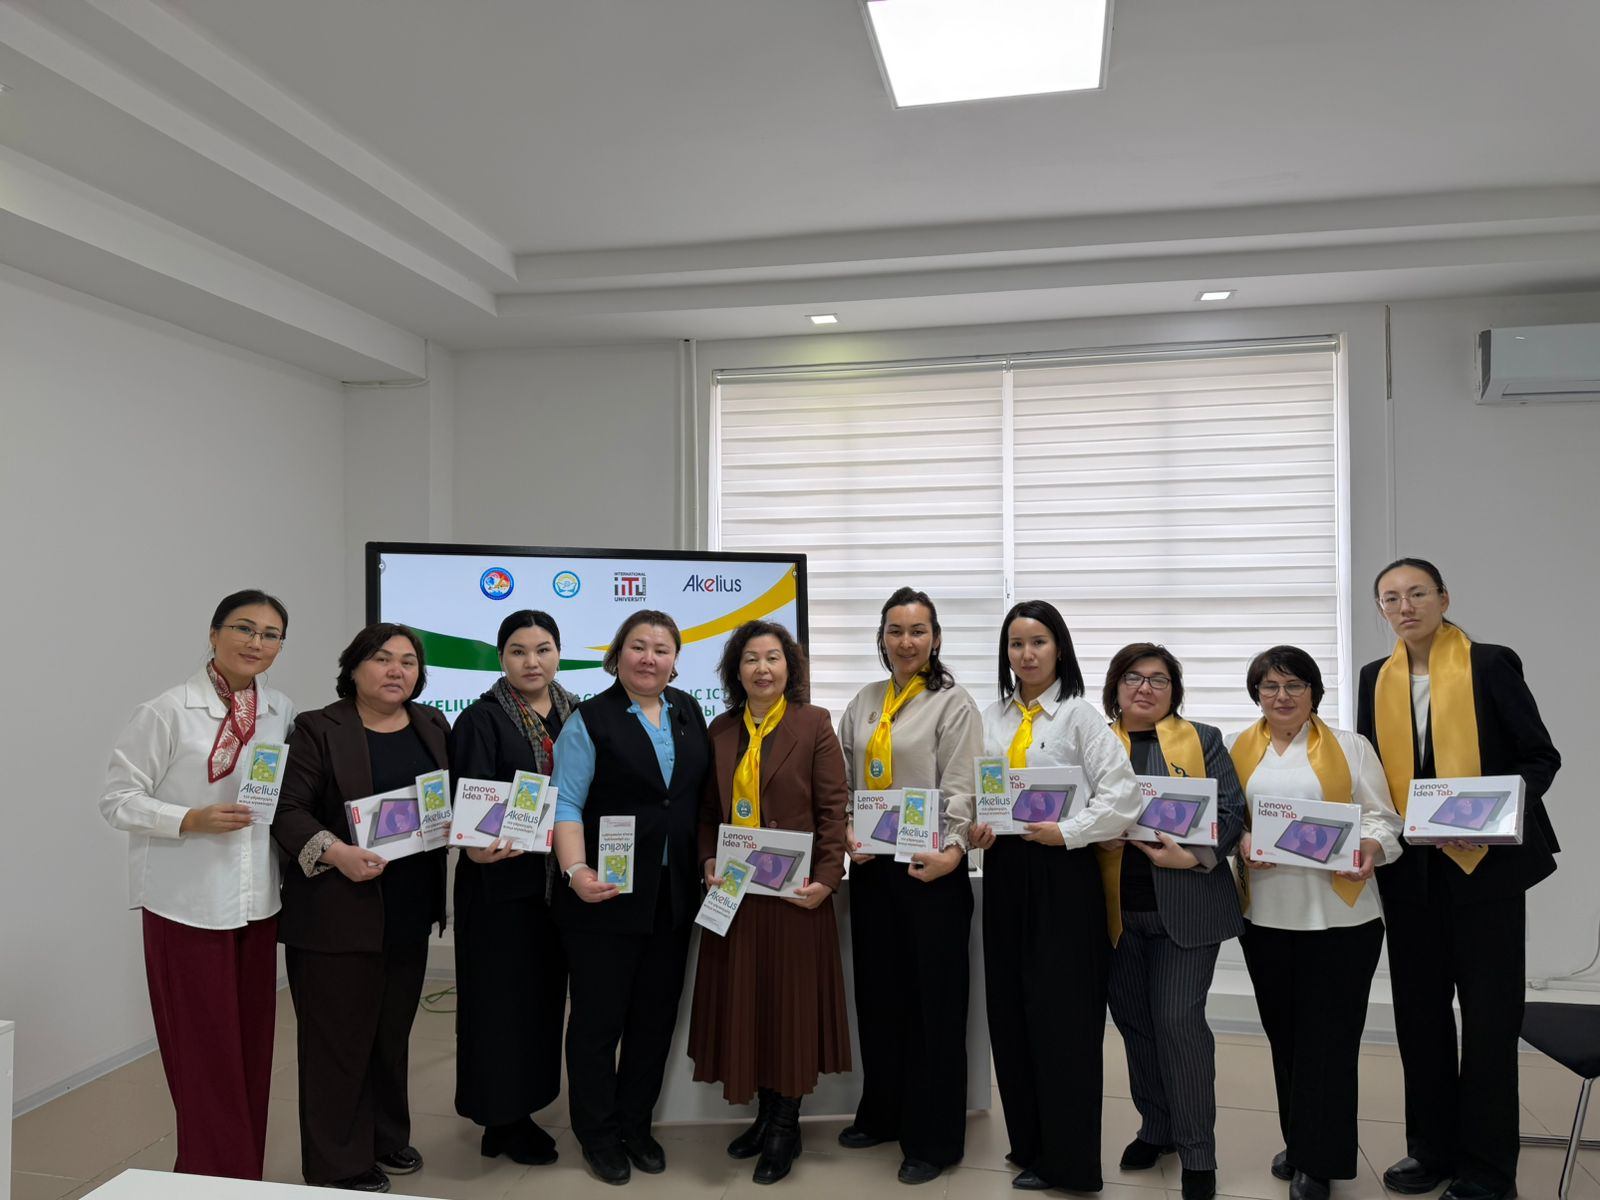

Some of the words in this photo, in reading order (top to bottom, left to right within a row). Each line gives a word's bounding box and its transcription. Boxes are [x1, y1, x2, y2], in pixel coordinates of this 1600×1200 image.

[683, 574, 742, 592] Akelius
[241, 783, 279, 796] Akelius
[463, 784, 496, 794] Lenovo
[1141, 788, 1157, 796] Tab
[462, 792, 482, 800] Idea
[484, 794, 500, 802] Tab
[978, 797, 1010, 806] Akelius
[1258, 801, 1292, 810] Lenovo
[422, 810, 452, 824] Akelius
[505, 810, 539, 824] Akelius
[1258, 808, 1278, 817] Idea
[1280, 810, 1297, 819] Tab
[723, 832, 753, 841] Lenovo
[899, 826, 928, 838] Akelius
[600, 842, 634, 852] Akelius
[722, 840, 740, 848] Idea
[743, 841, 757, 849] Tab
[708, 890, 738, 911] Akelius
